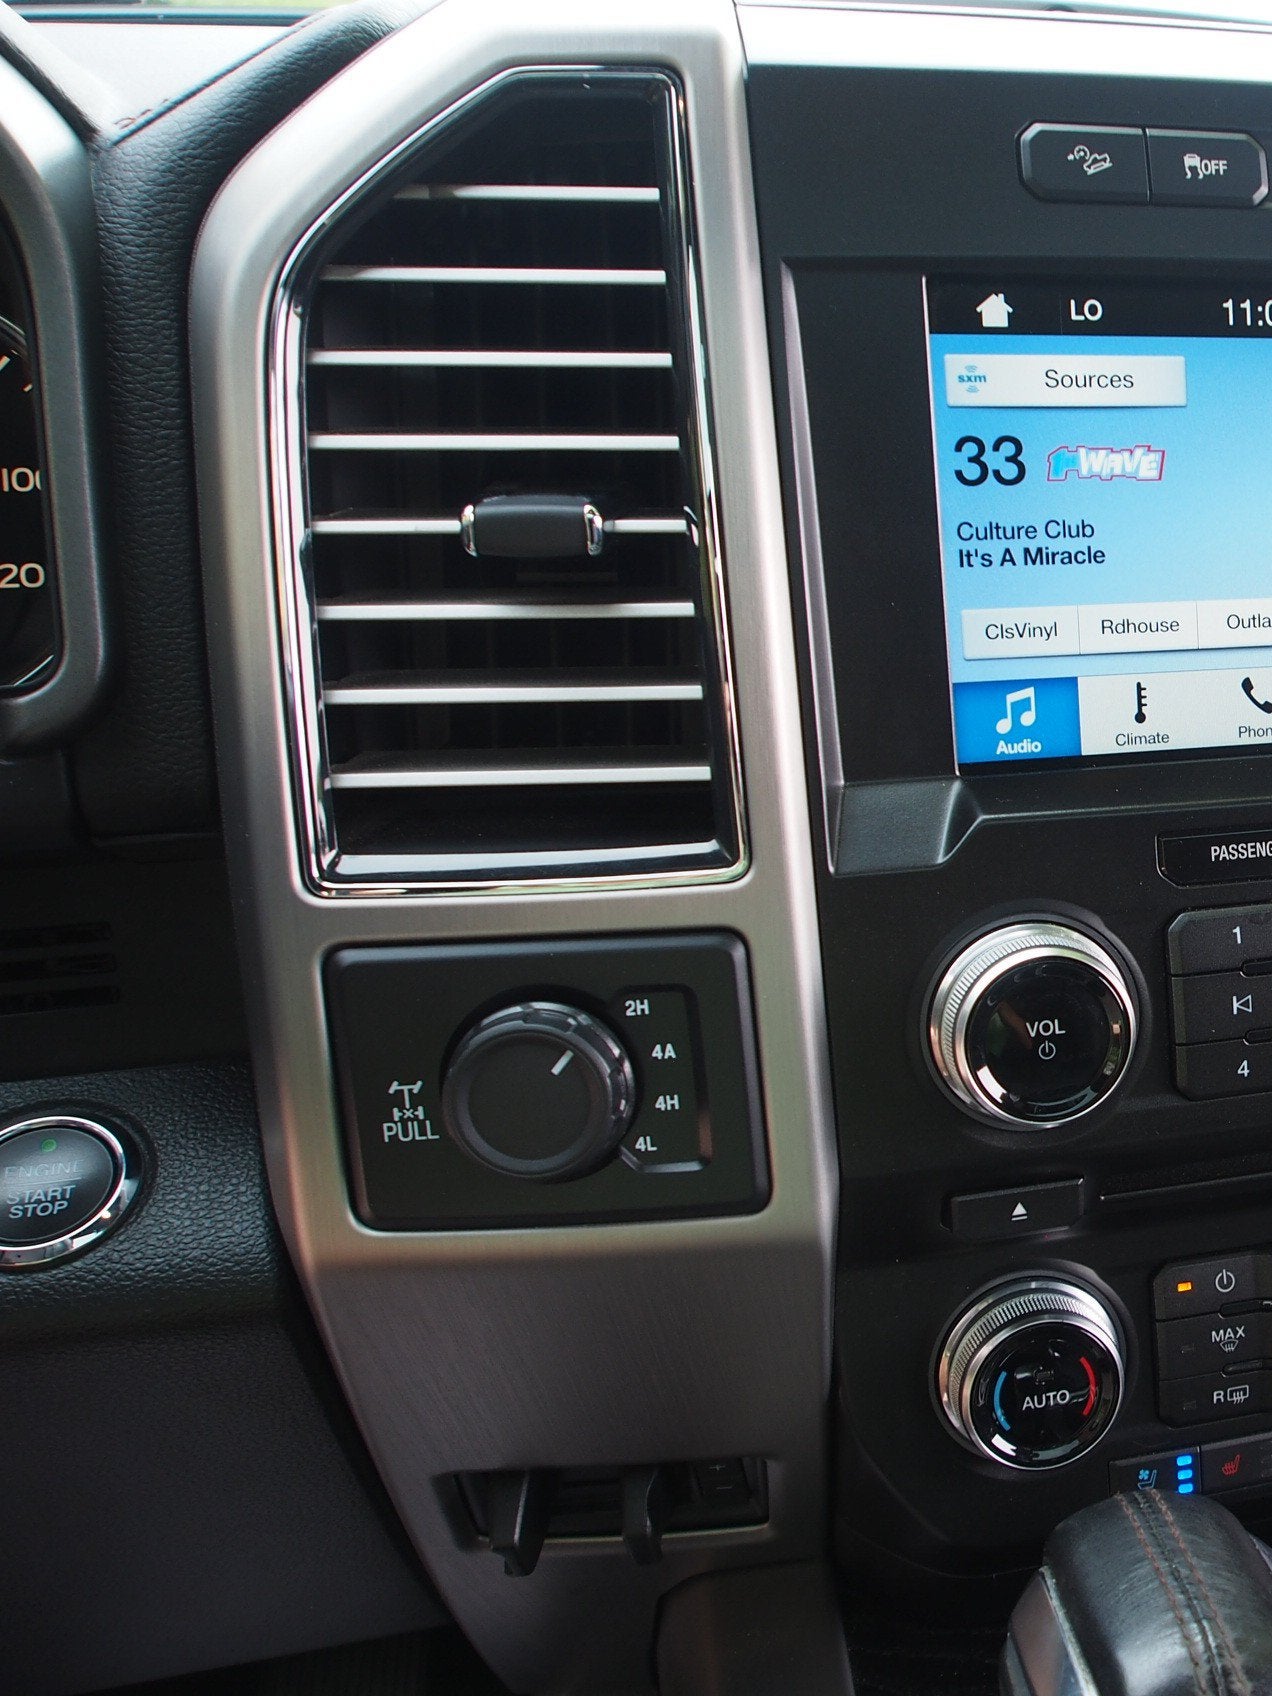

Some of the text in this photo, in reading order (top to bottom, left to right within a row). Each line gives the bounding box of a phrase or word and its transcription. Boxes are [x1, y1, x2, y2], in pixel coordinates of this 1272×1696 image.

[1200, 158, 1228, 177] OFF
[1070, 298, 1103, 321] LO
[957, 373, 988, 384] sxm
[1044, 369, 1134, 389] Sources
[953, 434, 1026, 487] 33
[956, 519, 1095, 541] Culture Club
[958, 545, 1106, 568] It's A Miracle
[985, 622, 1058, 642] ClsVinyl
[1101, 617, 1180, 635] Rdhouse
[996, 739, 1042, 755] Audio
[1115, 731, 1170, 747] Climate
[1232, 926, 1242, 944] 1
[624, 998, 650, 1017] 2H
[1025, 1018, 1066, 1038] VOL
[651, 1042, 677, 1060] 4A
[1237, 1060, 1250, 1078] 4
[655, 1094, 680, 1111] 4H
[382, 1119, 440, 1143] PULL
[635, 1135, 658, 1152] 4L
[4, 1158, 85, 1178] ENGINE
[6, 1184, 77, 1205] START
[8, 1200, 69, 1219] STOP
[1211, 1325, 1245, 1343] MAX
[1021, 1389, 1070, 1411] AUTO
[1213, 1390, 1224, 1404] R
